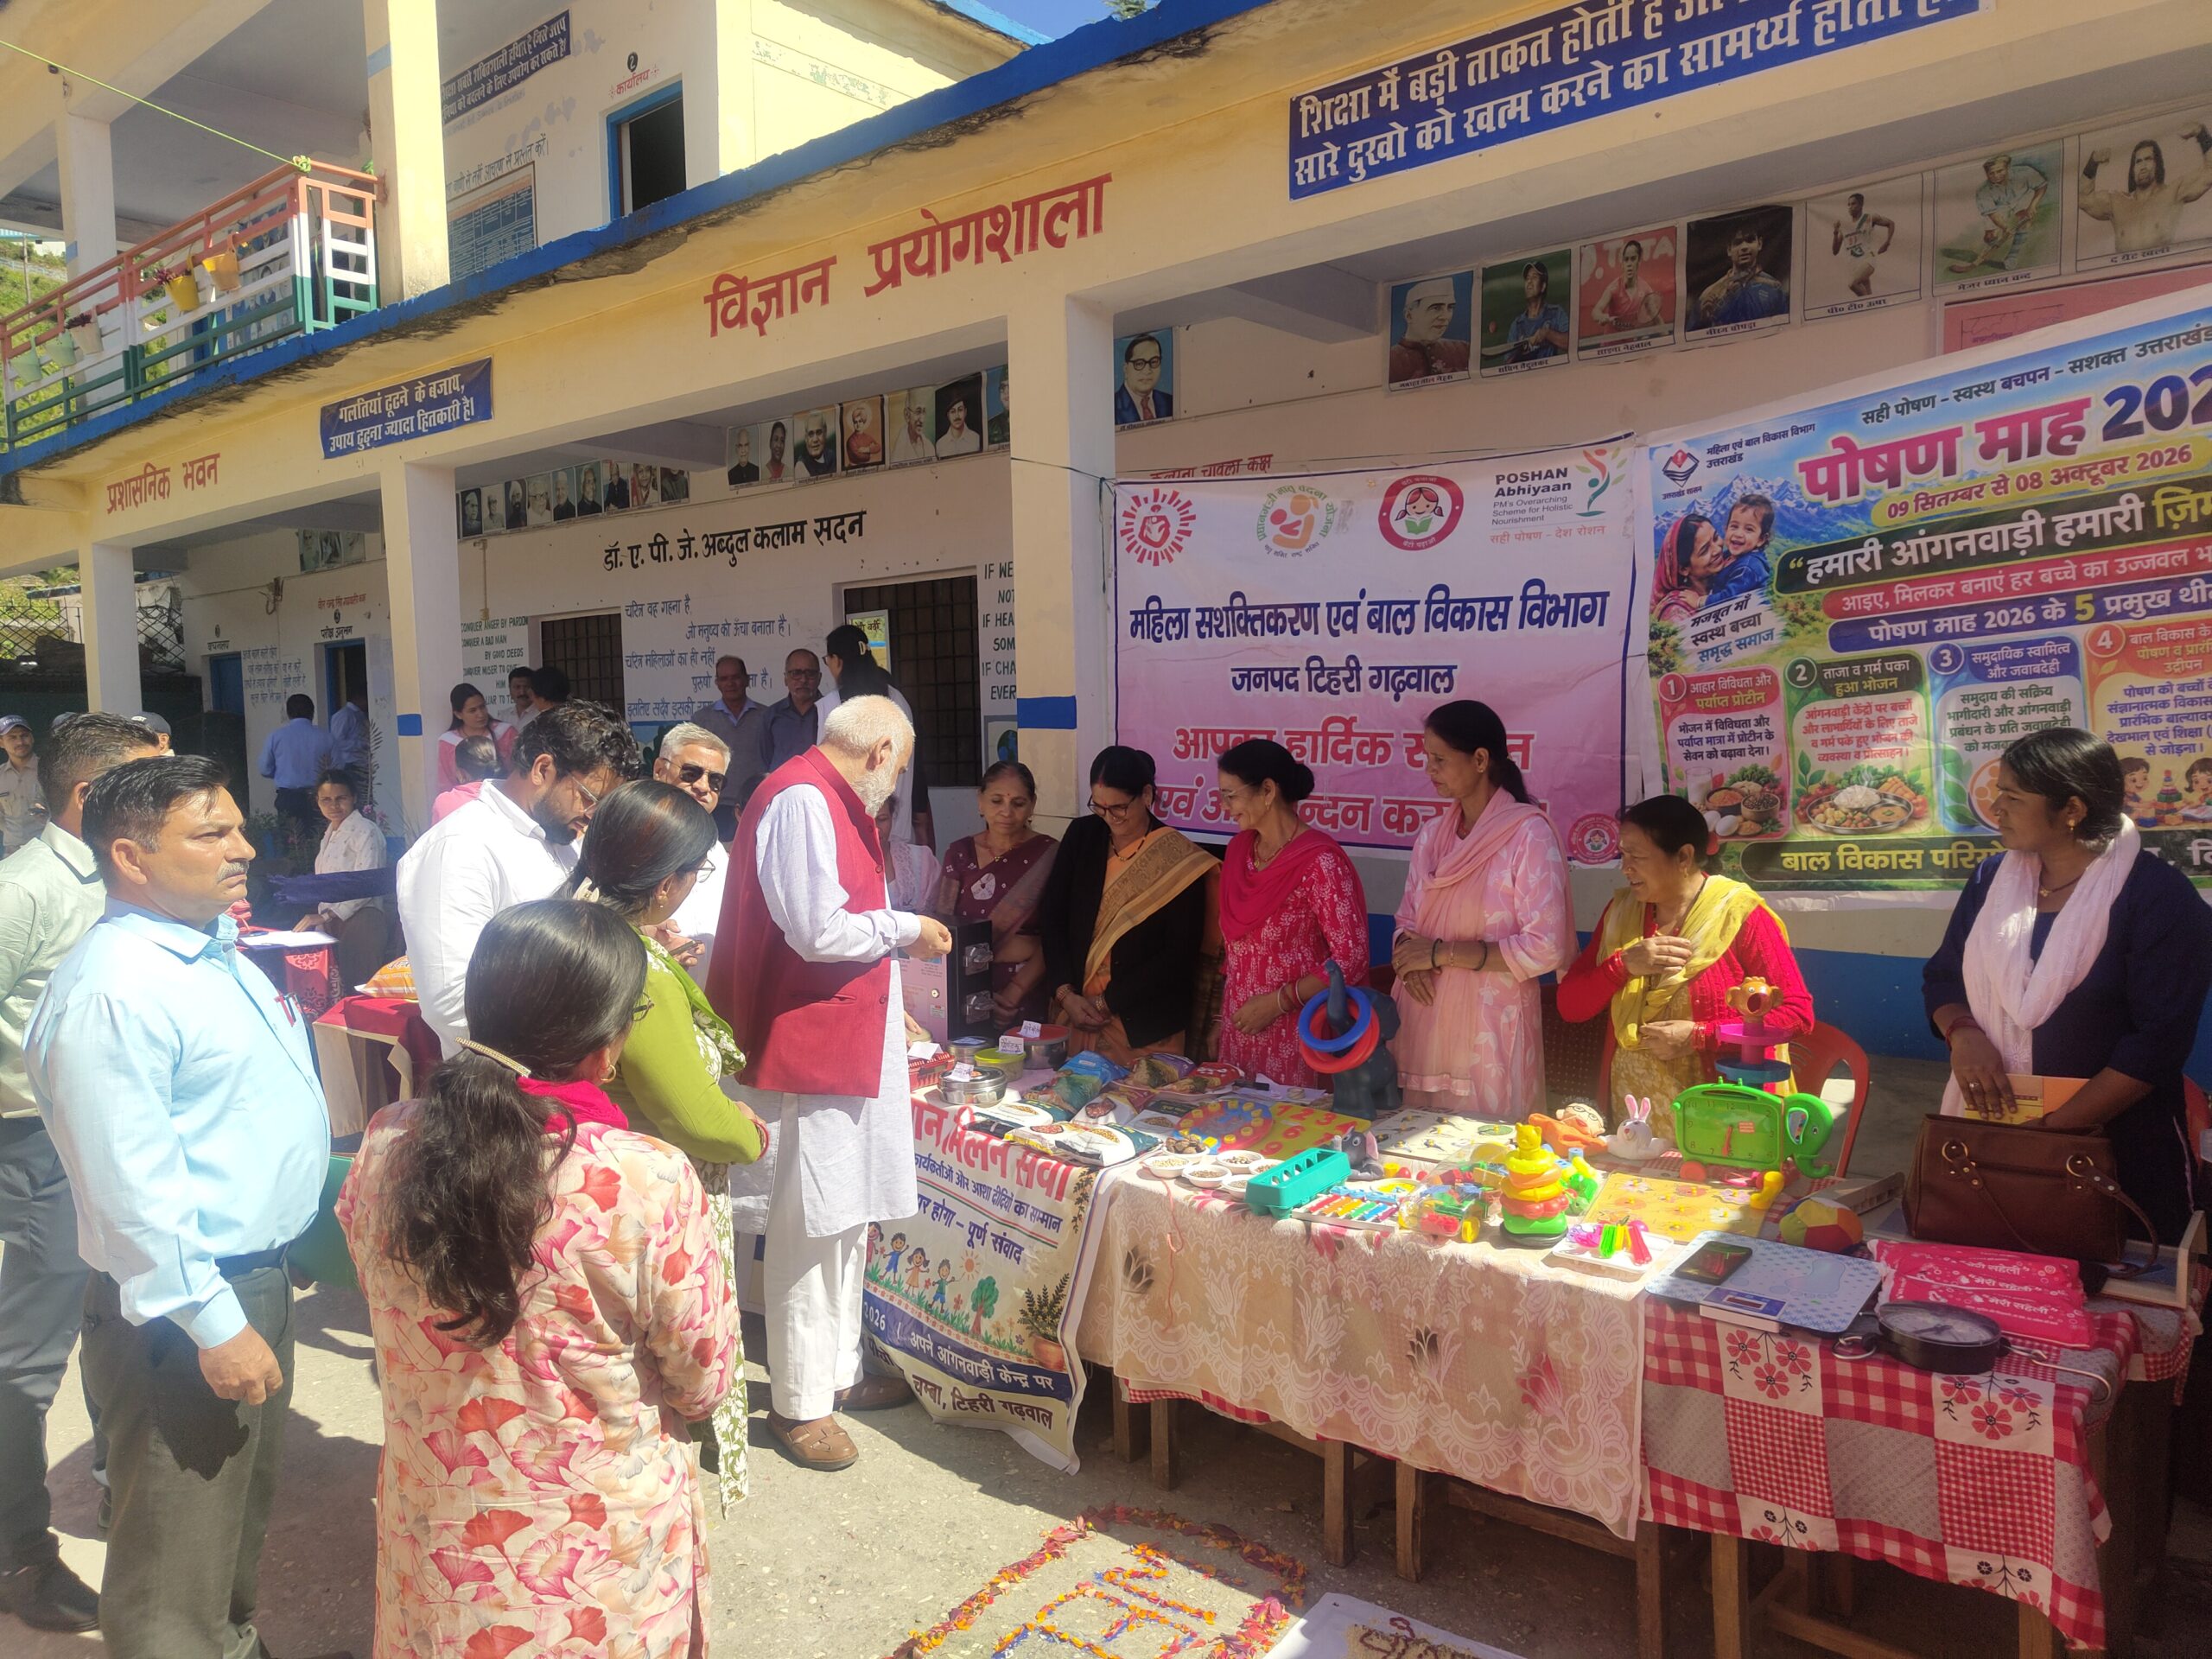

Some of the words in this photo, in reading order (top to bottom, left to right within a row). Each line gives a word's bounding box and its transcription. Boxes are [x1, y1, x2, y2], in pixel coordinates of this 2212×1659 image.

[1378, 67, 1401, 111] में
[1409, 50, 1459, 105] बड़ी
[1466, 27, 1553, 87] ताकत
[1295, 142, 1341, 186] सारे
[1415, 106, 1457, 150] को
[1541, 60, 1614, 115] करने
[1622, 48, 1671, 91] का
[703, 255, 837, 337] विज्ञान
[863, 172, 1112, 298] प्रयोगशाला
[1603, 235, 1674, 268] TTA
[1861, 404, 1890, 424] सही
[1894, 395, 1936, 417] पोषण
[1953, 380, 1995, 403] स्वस्थ
[2001, 366, 2050, 391] बचपन
[2068, 347, 2127, 373] सशक्त
[340, 392, 382, 423] गलतियां
[415, 381, 425, 403] के
[330, 433, 354, 452] उपाय
[417, 402, 461, 431] हितकारी
[1707, 443, 1730, 456] महिला
[1732, 438, 1743, 451] एवं
[1745, 436, 1760, 448] बाल
[1763, 429, 1789, 444] विकास
[1791, 423, 1815, 437] विभाग
[1707, 453, 1744, 469] उत्तराखंड
[1798, 426, 1962, 501] पोषण
[1974, 397, 2092, 463] माह
[1247, 454, 1274, 474] कक्ष
[1495, 467, 1567, 485] POSHAN
[107, 462, 170, 514] प्रशासनिक
[182, 453, 220, 491] भवन
[1494, 482, 1572, 498] Abhiyaan
[1887, 500, 1910, 518] 09
[1913, 482, 1986, 512] सितम्बर
[1991, 474, 2010, 496] से
[2016, 472, 2043, 493] 08
[2050, 456, 2130, 486] अक्टूबर
[2136, 443, 2192, 472] 2026
[1492, 508, 1526, 517] Scheme
[1541, 503, 1573, 512] Holistic
[1516, 495, 1567, 506] Overarching
[1489, 532, 1510, 544] सही
[1514, 531, 1542, 542] पोषण
[1555, 527, 1573, 538] देश
[1576, 525, 1606, 536] रोशन
[1491, 515, 1545, 525] Nourishment
[1891, 509, 2045, 567] आंगनवाड़ी
[2052, 493, 2145, 546] हमारी
[628, 543, 644, 569] ए.
[649, 533, 672, 563] पी.
[677, 528, 698, 560] जे.
[702, 528, 751, 567] अब्दुल
[753, 519, 807, 549] कलाम
[814, 510, 867, 545] सदन
[984, 563, 994, 579] IF
[1894, 582, 1955, 605] मिलकर
[1961, 572, 2004, 594] बनाएं
[2011, 570, 2032, 591] हर
[2038, 560, 2077, 584] बच्चे
[2083, 557, 2108, 578] का
[2115, 549, 2190, 575] उज्जवल
[647, 602, 658, 618] वह
[661, 599, 682, 615] गहना
[1129, 595, 1191, 643] महिला
[1195, 591, 1320, 639] सशक्तिकरण
[1325, 588, 1367, 638] एवं
[1366, 600, 1421, 636] बाल
[1425, 584, 1513, 632] विकास
[1518, 579, 1610, 629] विभाग
[1691, 608, 1730, 627] मजबूत
[1868, 619, 1927, 642] पोषण
[1934, 613, 1977, 634] माह
[1984, 607, 2036, 628] 2026
[2041, 598, 2066, 622] के
[2075, 594, 2095, 621] 5
[2104, 588, 2171, 619] प्रमुख
[752, 620, 775, 635] बनाता
[1691, 624, 1725, 645] स्वस्थ
[1731, 613, 1762, 632] बच्चा
[1698, 644, 1732, 663] समृद्ध
[1737, 629, 1775, 651] समाज
[1940, 649, 1952, 668] 3
[2027, 641, 2071, 658] स्वामित्व
[1230, 667, 1300, 691] जनपद
[1306, 655, 1362, 695] टिहरी
[1368, 665, 1458, 702] गढ़वाल
[1690, 681, 1715, 693] आहार
[1718, 676, 1752, 691] विविधता
[1756, 674, 1772, 689] और
[1796, 664, 1807, 681] 2
[1823, 666, 1850, 680] ताजा
[1853, 666, 1861, 677] व
[1863, 661, 1882, 676] गर्म
[1885, 659, 1910, 673] पका
[1987, 664, 2007, 679] और
[2010, 660, 2060, 677] जवाबदेही
[1667, 680, 1675, 695] 1
[1695, 693, 1730, 709] पर्याप्त
[1732, 690, 1765, 706] प्रोटीन
[1834, 680, 1859, 697] हुआ
[1862, 677, 1898, 691] भोजन
[1678, 721, 1702, 734] भोजन
[1704, 718, 1713, 732] में
[1714, 717, 1751, 731] विविधता
[1753, 716, 1770, 728] और
[1284, 715, 1394, 766] हार्दिक
[1781, 850, 1831, 872] बाल
[1837, 843, 1923, 869] विकास
[1029, 1205, 1063, 1234] सम्मान
[968, 1221, 988, 1249] पूर्ण
[991, 1230, 1025, 1265] संवाद
[910, 1331, 934, 1358] अपने
[937, 1344, 995, 1382] आंगनवाड़ी
[1033, 1374, 1054, 1390] पर
[952, 1387, 996, 1413] टिहरी
[998, 1400, 1053, 1430] गढ़वाल
